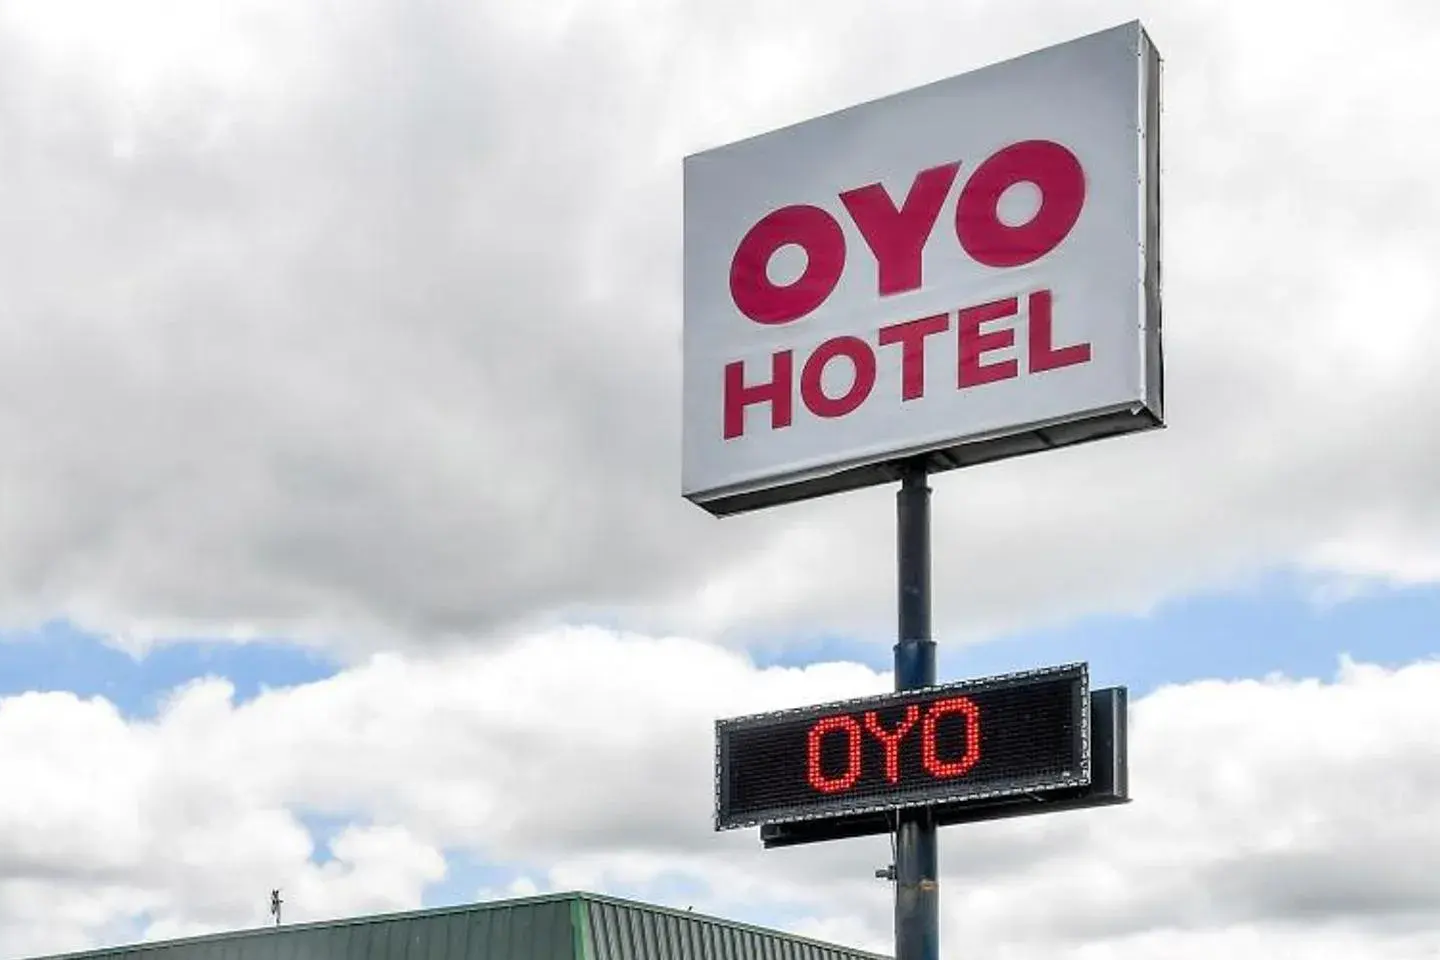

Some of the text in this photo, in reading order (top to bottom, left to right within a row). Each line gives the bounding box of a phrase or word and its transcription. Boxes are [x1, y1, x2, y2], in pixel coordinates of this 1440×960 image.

[729, 139, 1086, 325] OYO
[723, 289, 1091, 440] HOTEL
[807, 696, 981, 793] OYO
